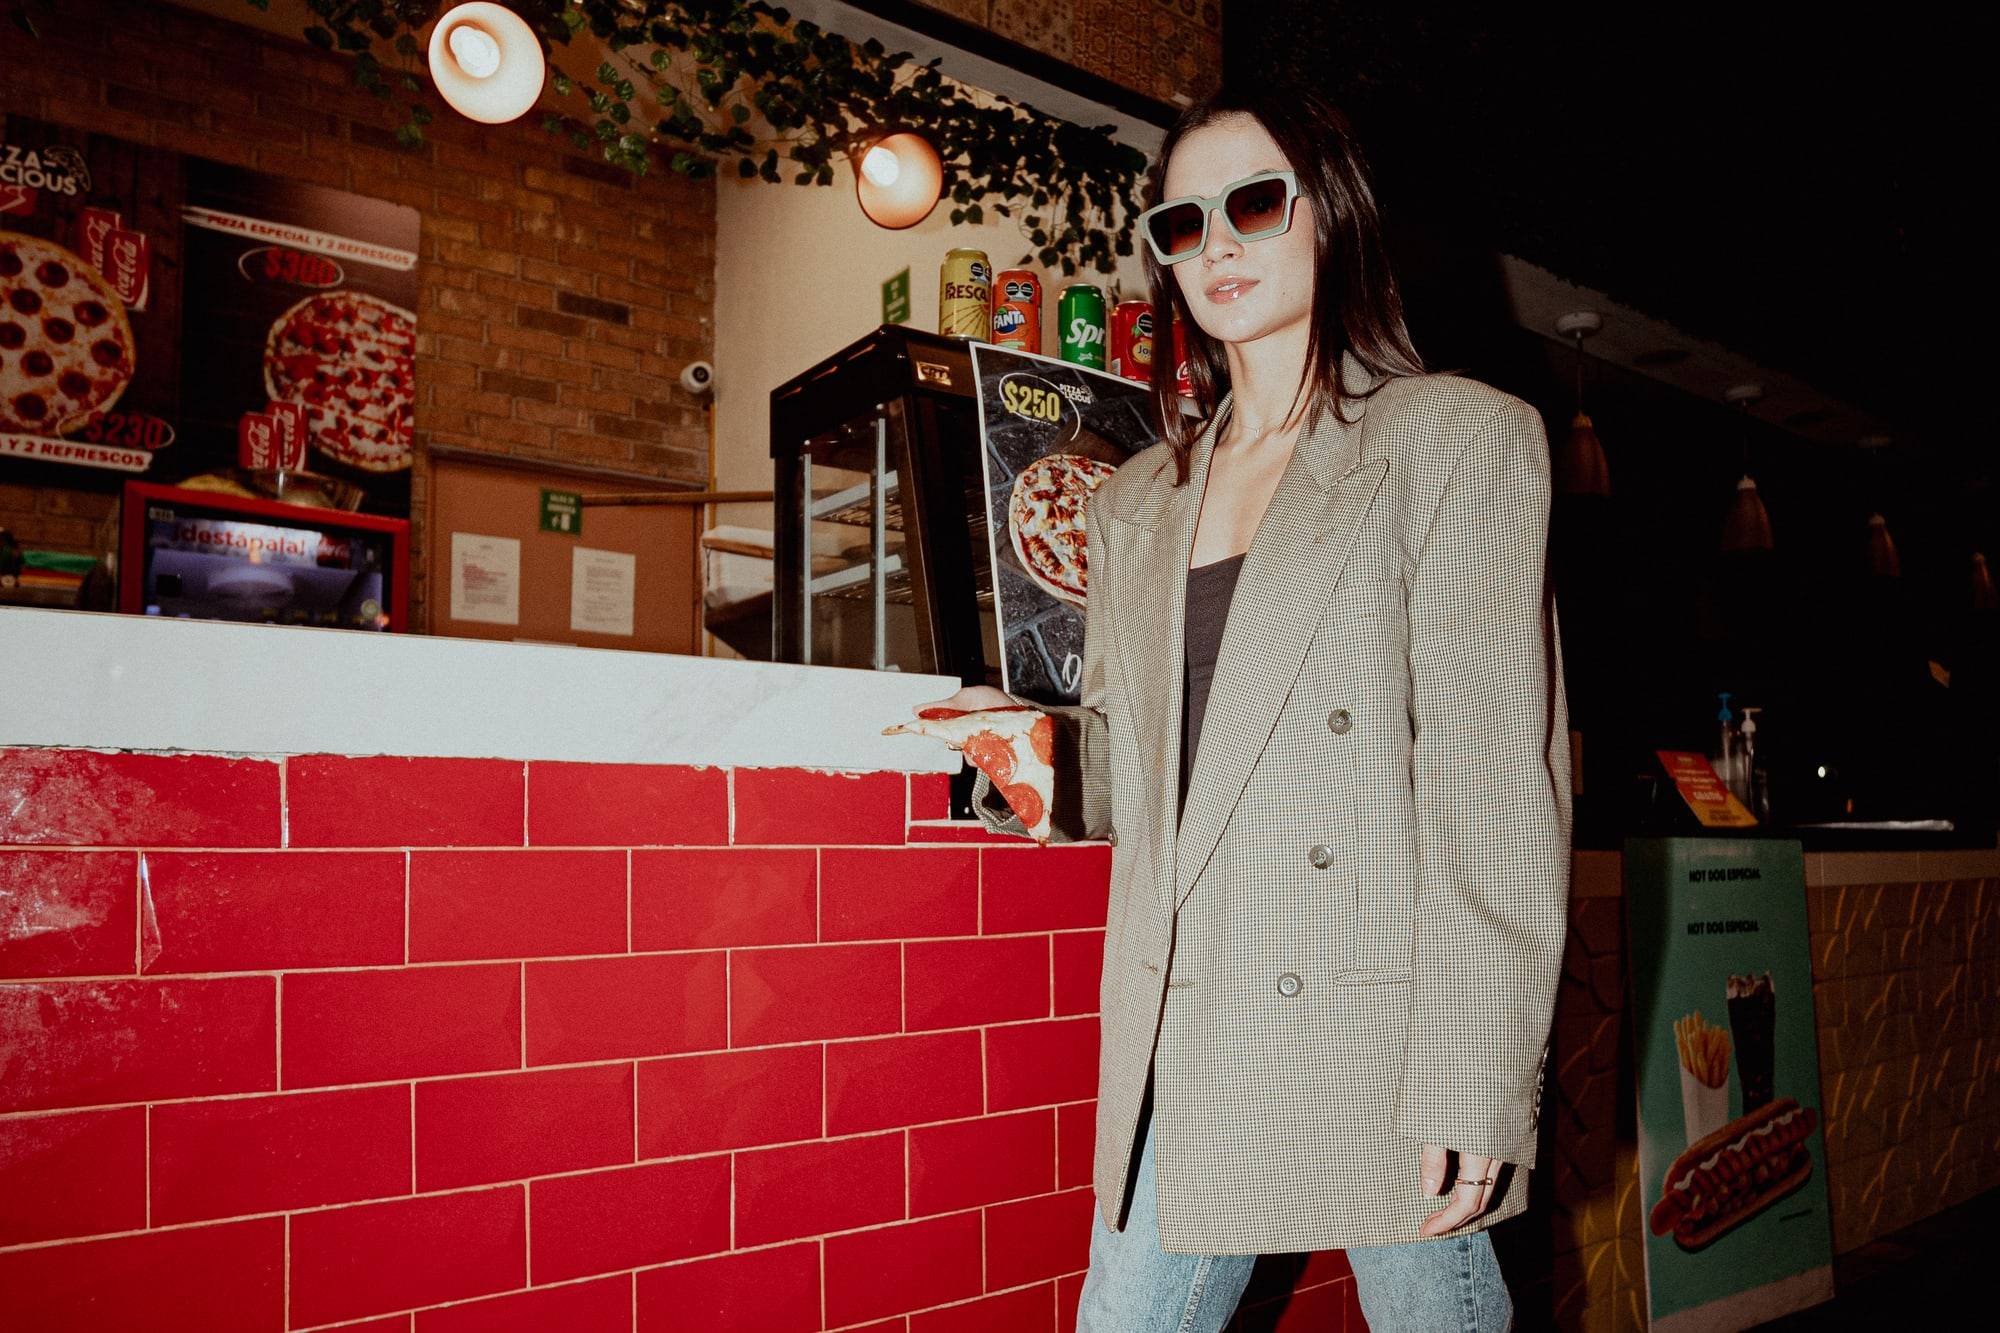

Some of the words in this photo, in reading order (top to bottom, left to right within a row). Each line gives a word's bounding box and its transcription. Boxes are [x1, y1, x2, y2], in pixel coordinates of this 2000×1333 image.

[207, 213, 246, 231] PIZZA
[251, 223, 311, 245] ESPECIAL
[945, 282, 988, 303] FRESCA
[993, 310, 1025, 331] FANTA
[1004, 381, 1061, 422] $250
[85, 410, 165, 450] $230
[8, 438, 19, 451] Y
[23, 441, 36, 454] 2
[40, 443, 145, 467] REFRESCOS
[1689, 869, 1706, 882] HOT
[1708, 868, 1725, 881] DOG
[1688, 922, 1704, 935] HOT
[1706, 921, 1723, 934] DOG
